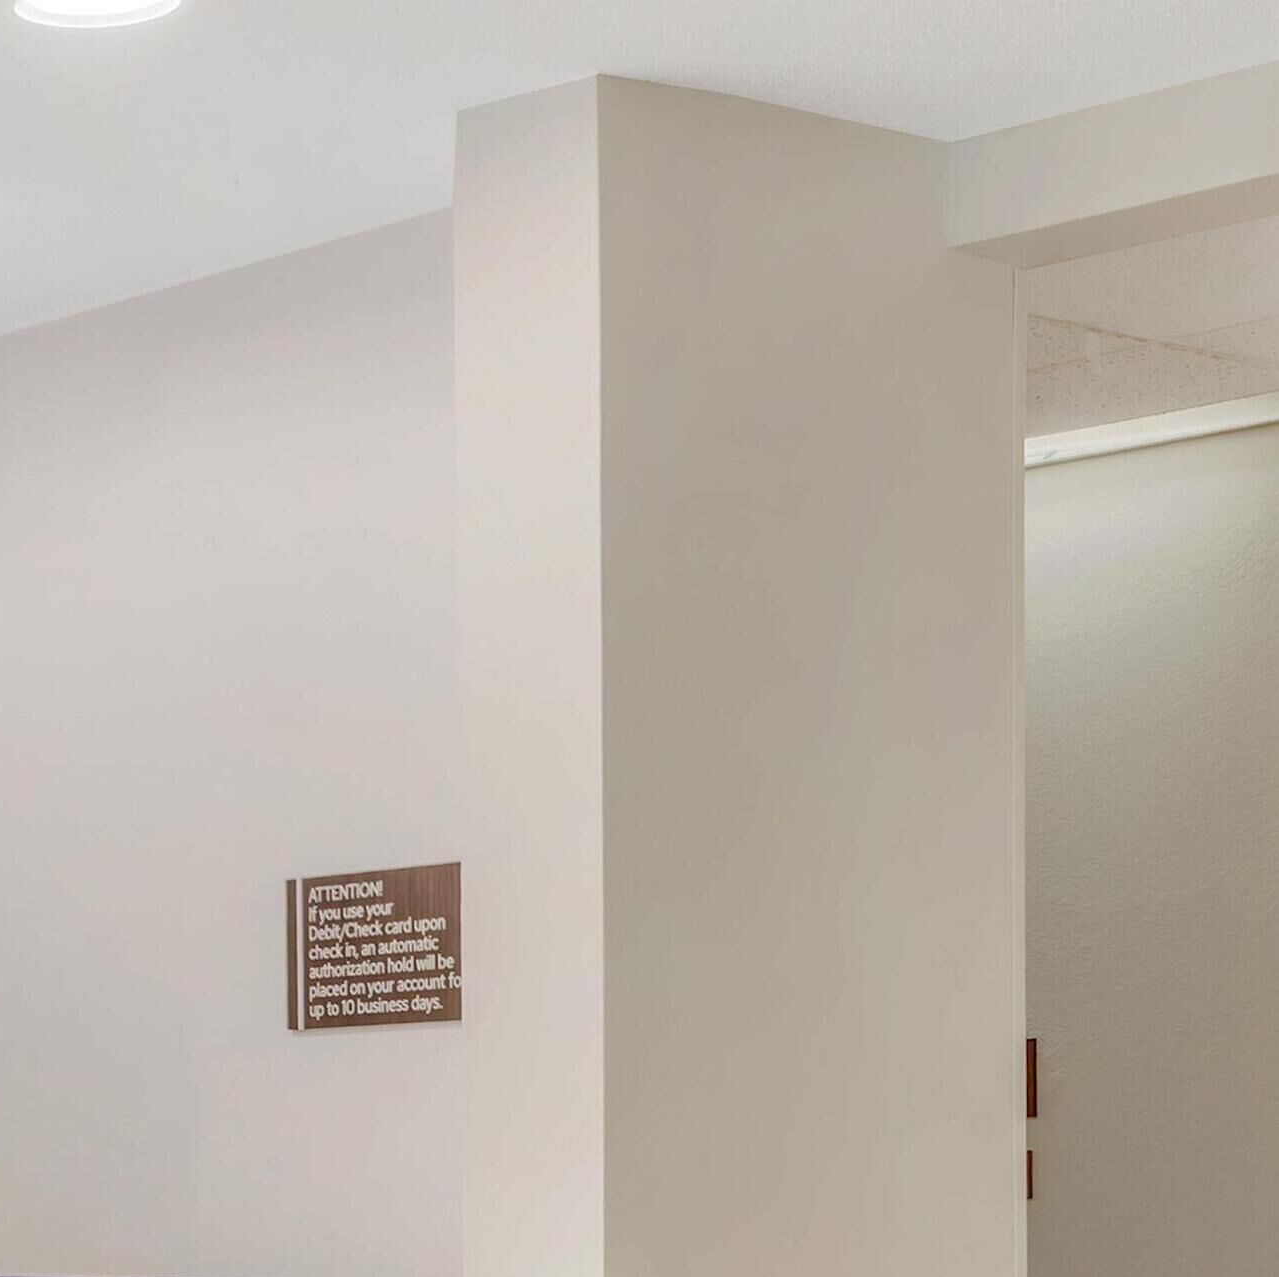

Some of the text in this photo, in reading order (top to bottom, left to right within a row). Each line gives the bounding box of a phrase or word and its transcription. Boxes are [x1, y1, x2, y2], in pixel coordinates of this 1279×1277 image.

[308, 881, 383, 904] ATTENTION!
[308, 902, 394, 925] If you use your
[309, 917, 446, 944] Debit/Check card upon
[309, 936, 439, 960] check in, an automatic
[309, 954, 454, 979] authorization hold will be
[309, 974, 461, 1001] placed on your account fo
[309, 995, 443, 1020] up to 10 business days.
